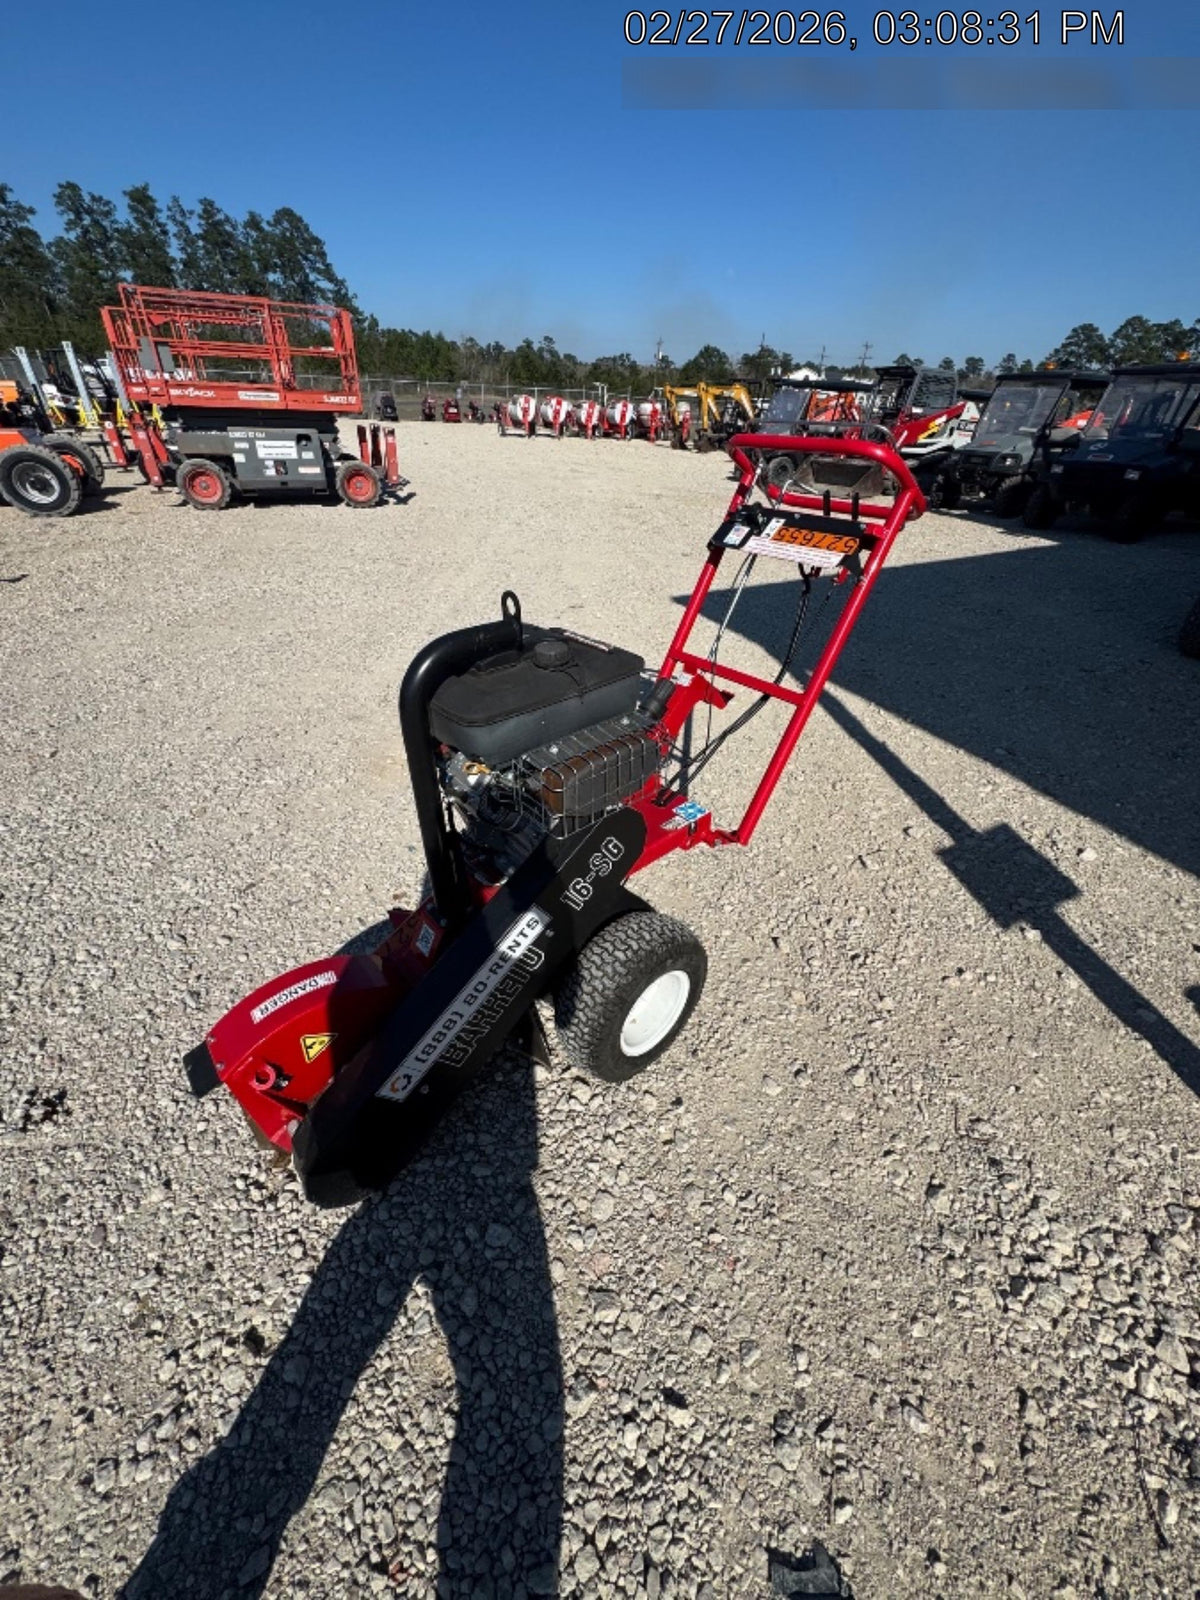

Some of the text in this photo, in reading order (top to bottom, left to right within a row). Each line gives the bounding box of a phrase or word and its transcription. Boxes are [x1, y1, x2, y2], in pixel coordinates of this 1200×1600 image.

[776, 527, 858, 551] 527655
[560, 837, 624, 911] 16-SG
[464, 916, 541, 1008] 80-RENTS
[259, 979, 319, 1016] DANGER
